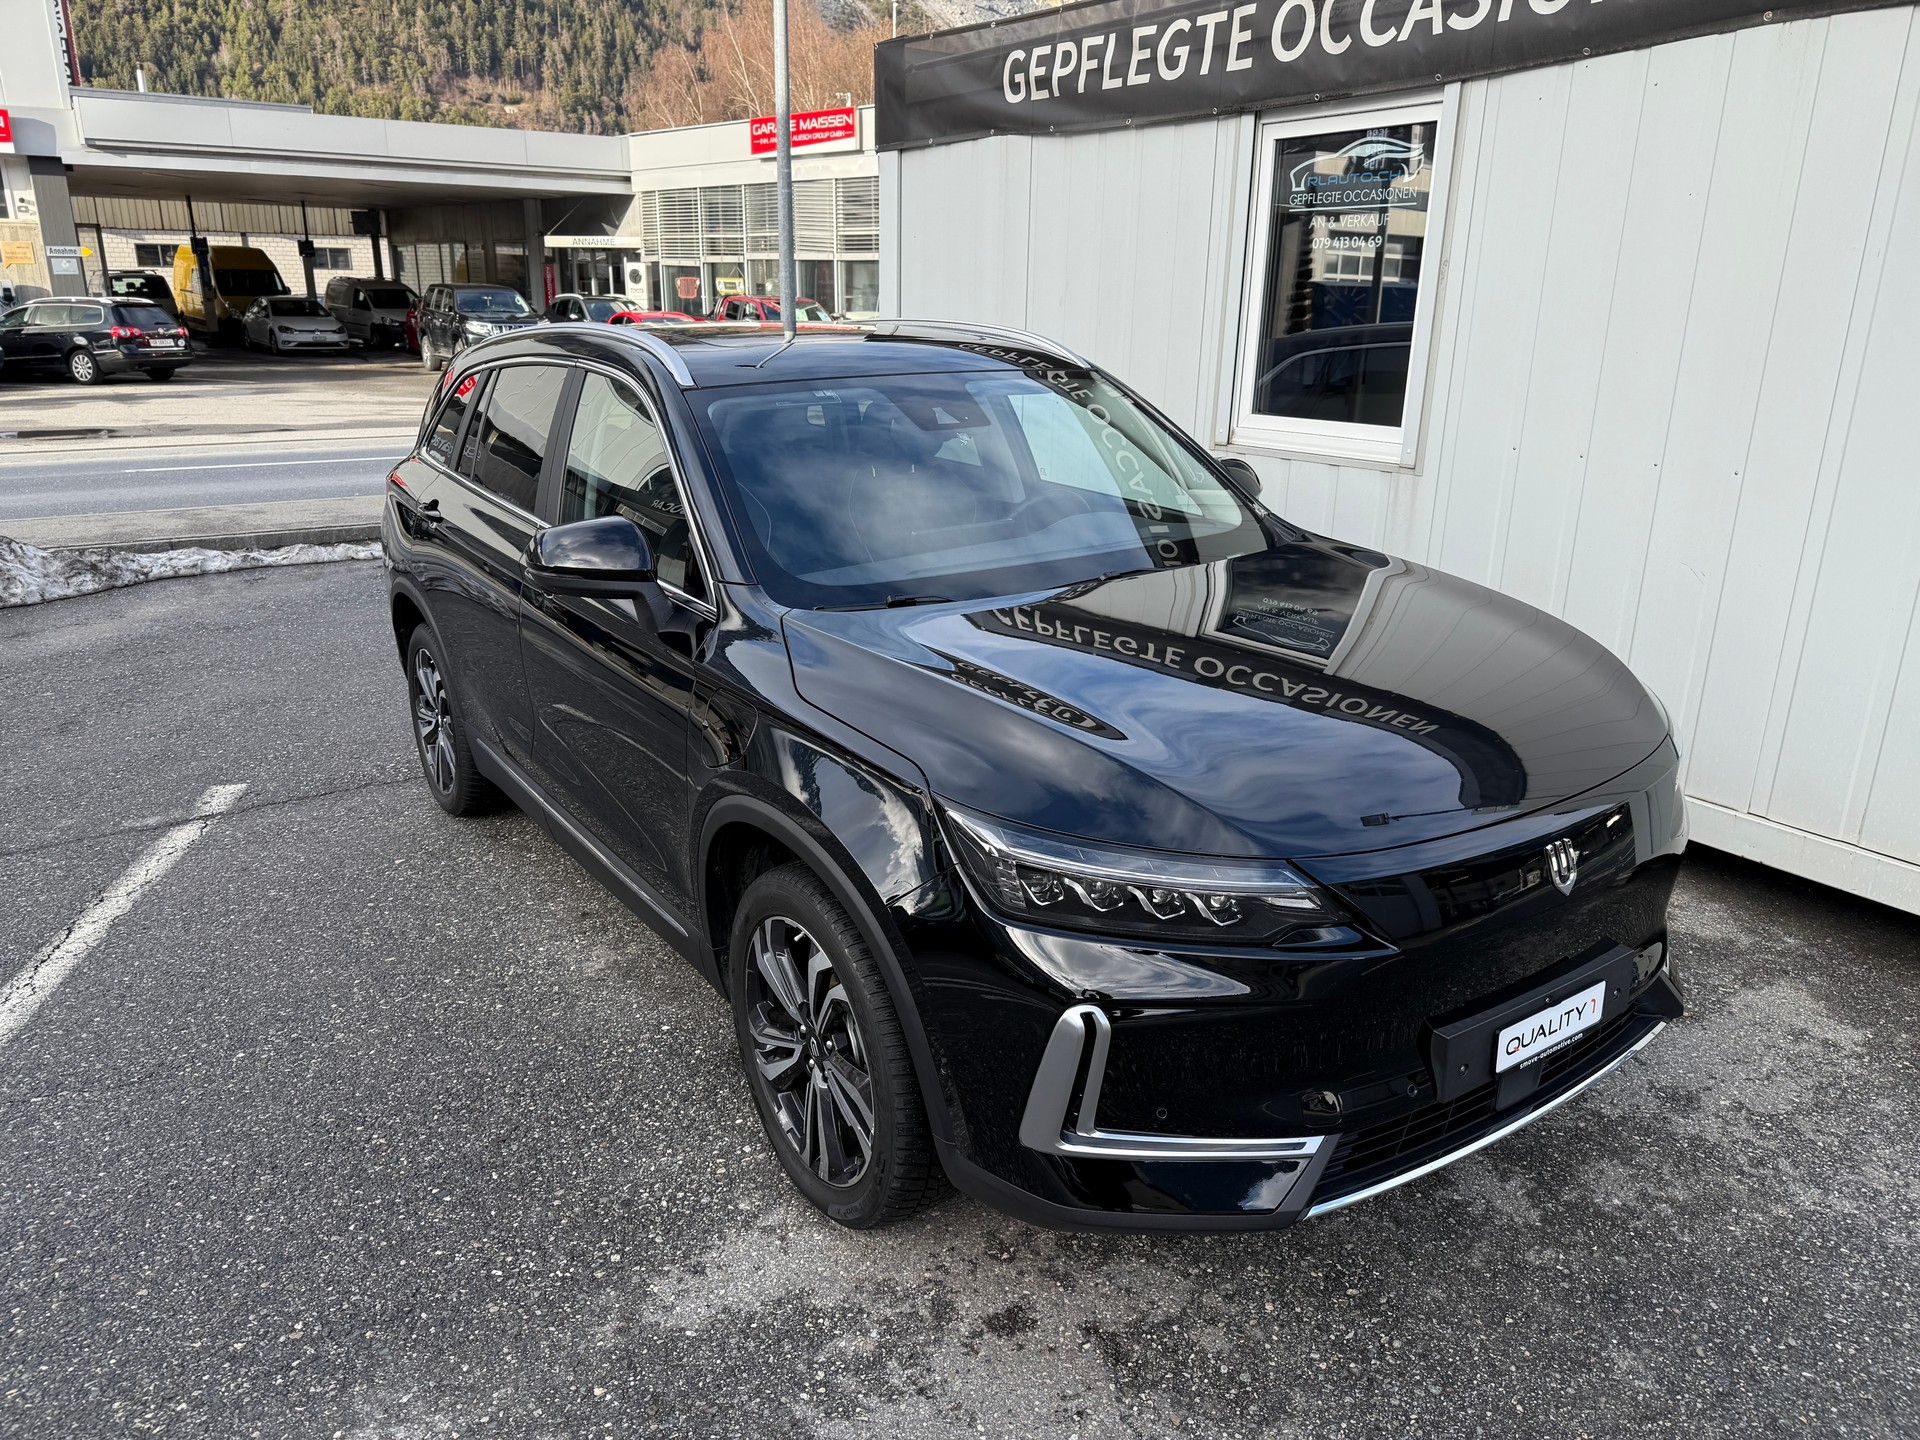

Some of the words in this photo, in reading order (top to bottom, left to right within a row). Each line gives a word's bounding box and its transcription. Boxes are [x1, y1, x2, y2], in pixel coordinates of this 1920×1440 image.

[1003, 3, 1257, 103] GEPFLEGTE
[752, 119, 796, 136] GARE
[800, 113, 853, 130] MAISSEN
[1289, 191, 1342, 206] GEPFLEGTE
[1343, 187, 1417, 203] OCCASIONEN
[1309, 216, 1325, 229] AN
[1328, 216, 1336, 229] &
[1340, 213, 1390, 228] VERKAUF
[49, 247, 78, 255] Annahme
[572, 238, 616, 246] ANNAHME
[1312, 237, 1331, 250] 079
[1332, 236, 1349, 249] 413
[1351, 235, 1366, 248] 04
[1367, 235, 1382, 248] 69
[1505, 1001, 1588, 1056] QUALITY
[1519, 1032, 1584, 1070] smove-automotive.com
